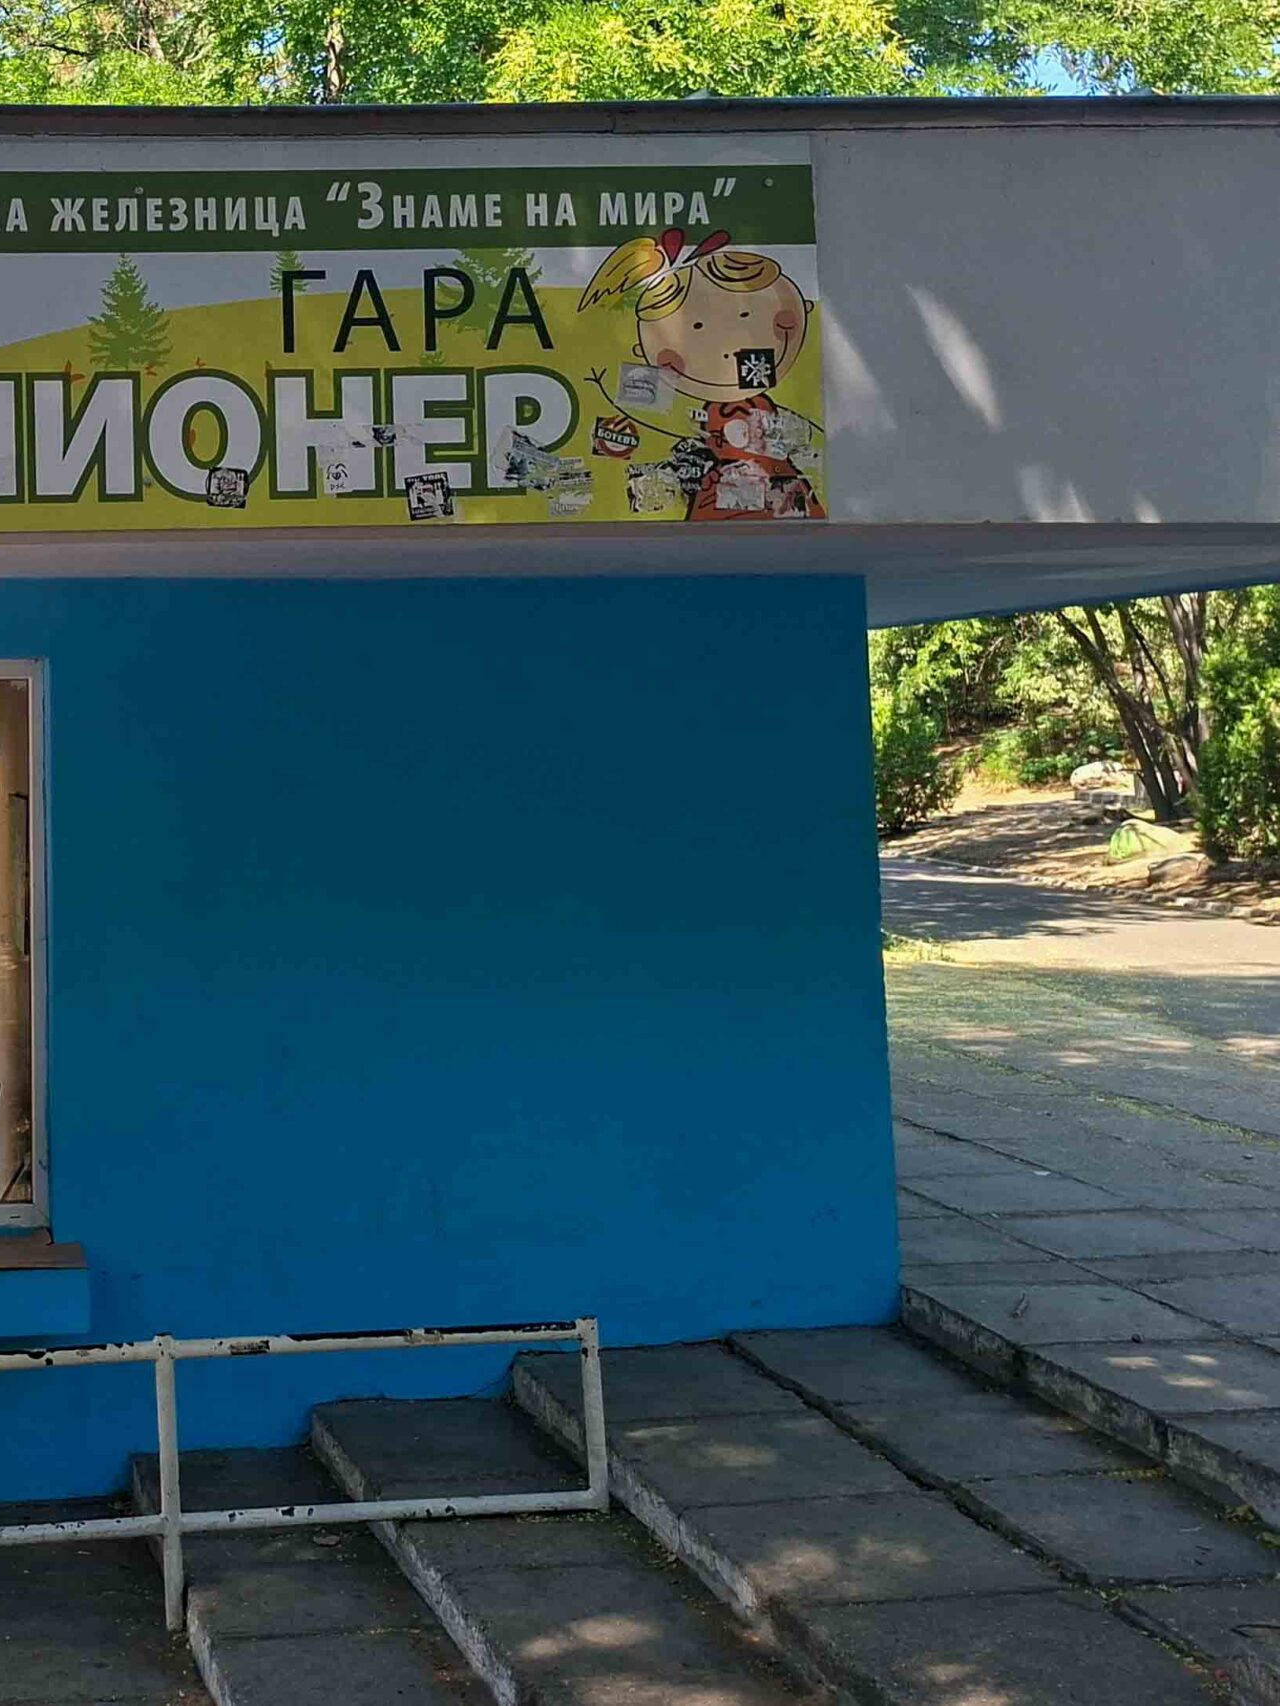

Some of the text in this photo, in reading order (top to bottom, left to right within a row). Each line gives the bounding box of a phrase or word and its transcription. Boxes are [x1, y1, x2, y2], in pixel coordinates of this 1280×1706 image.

[50, 196, 307, 237] ЖЕЛЕЗНИЦА
[526, 193, 577, 227] НА
[282, 268, 555, 353] ГАРА
